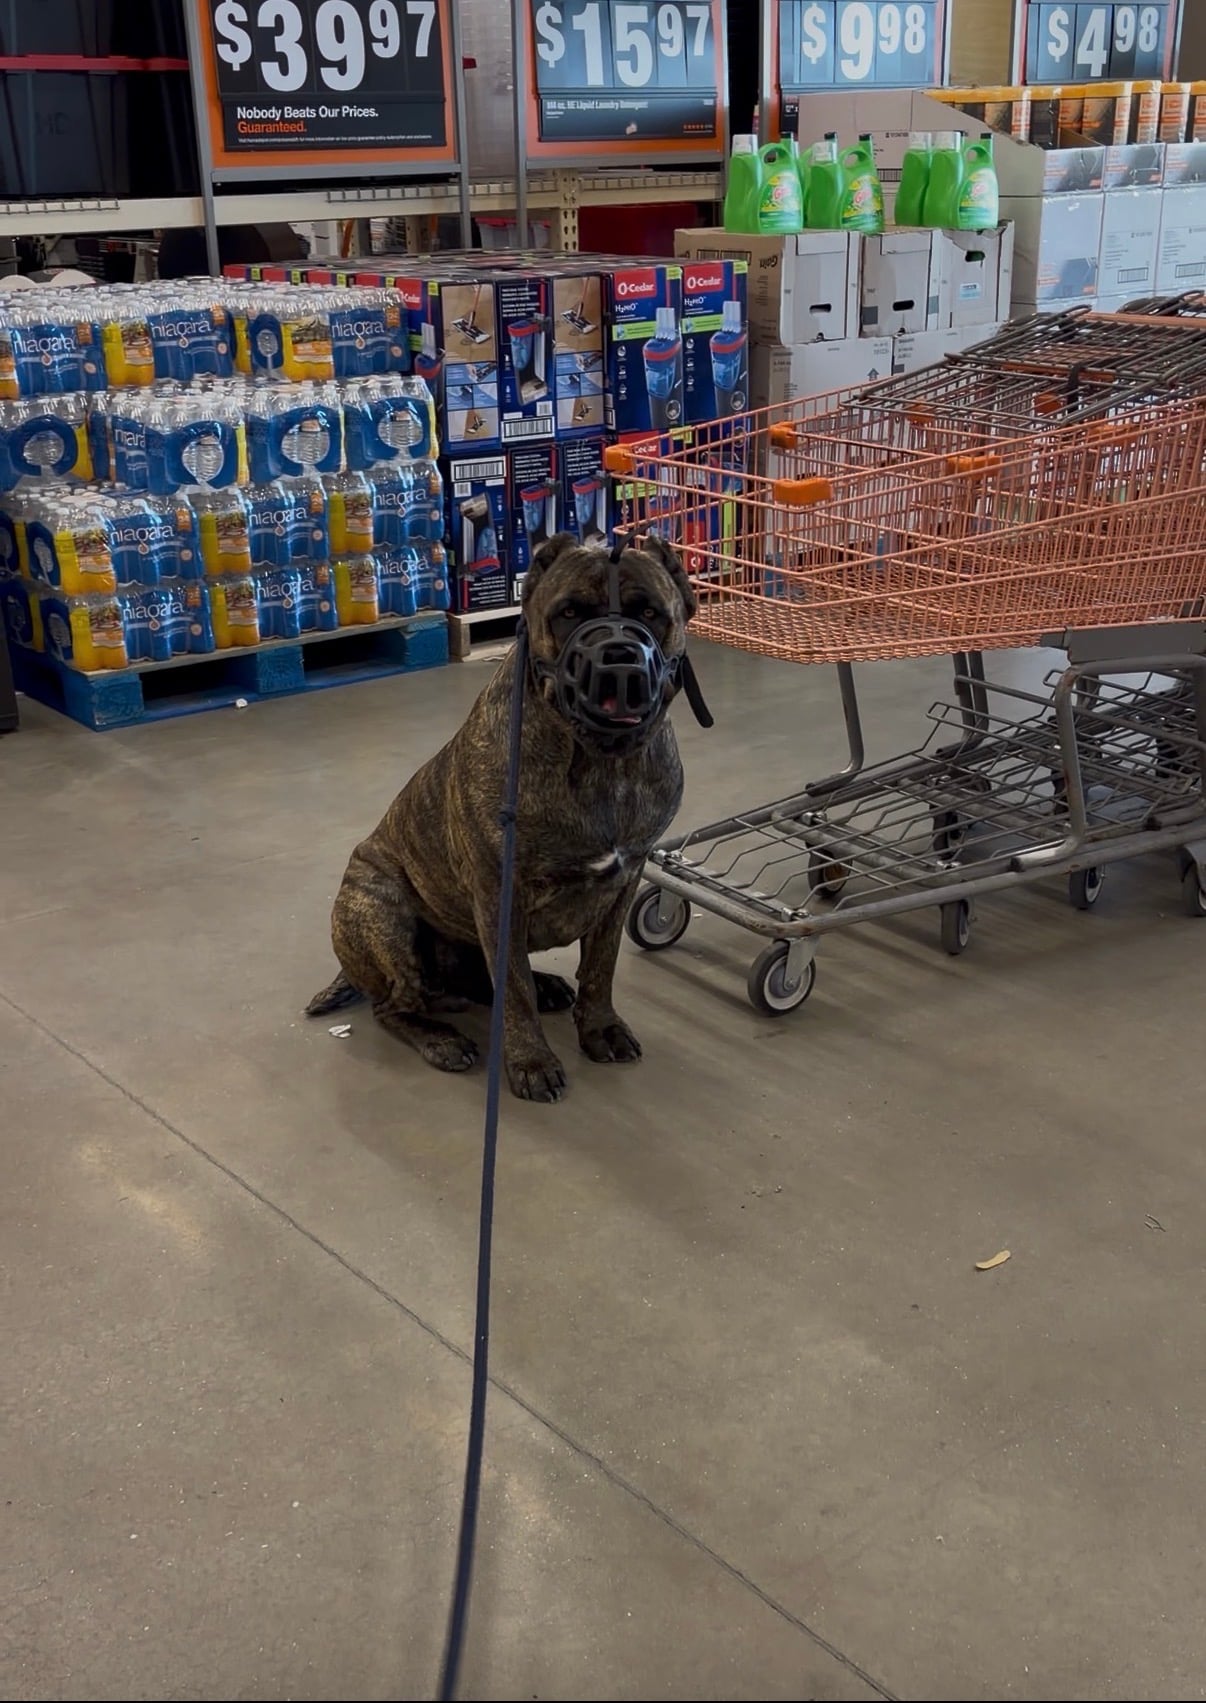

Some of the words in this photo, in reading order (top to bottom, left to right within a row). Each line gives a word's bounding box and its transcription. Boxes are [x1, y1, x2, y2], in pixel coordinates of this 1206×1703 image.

[237, 106, 282, 121] Nobody
[284, 106, 316, 118] Beats
[318, 105, 340, 118] Our
[341, 105, 379, 117] Prices.
[238, 121, 307, 134] Guaranteed.
[13, 333, 77, 366] niagara
[151, 320, 213, 349] niagara
[331, 320, 385, 350] niagara
[373, 488, 428, 518] niagara
[248, 506, 308, 537] niagara
[110, 524, 175, 555] niagara
[377, 556, 431, 586] niagara
[256, 579, 315, 609] niagara
[123, 601, 185, 631] niagara
